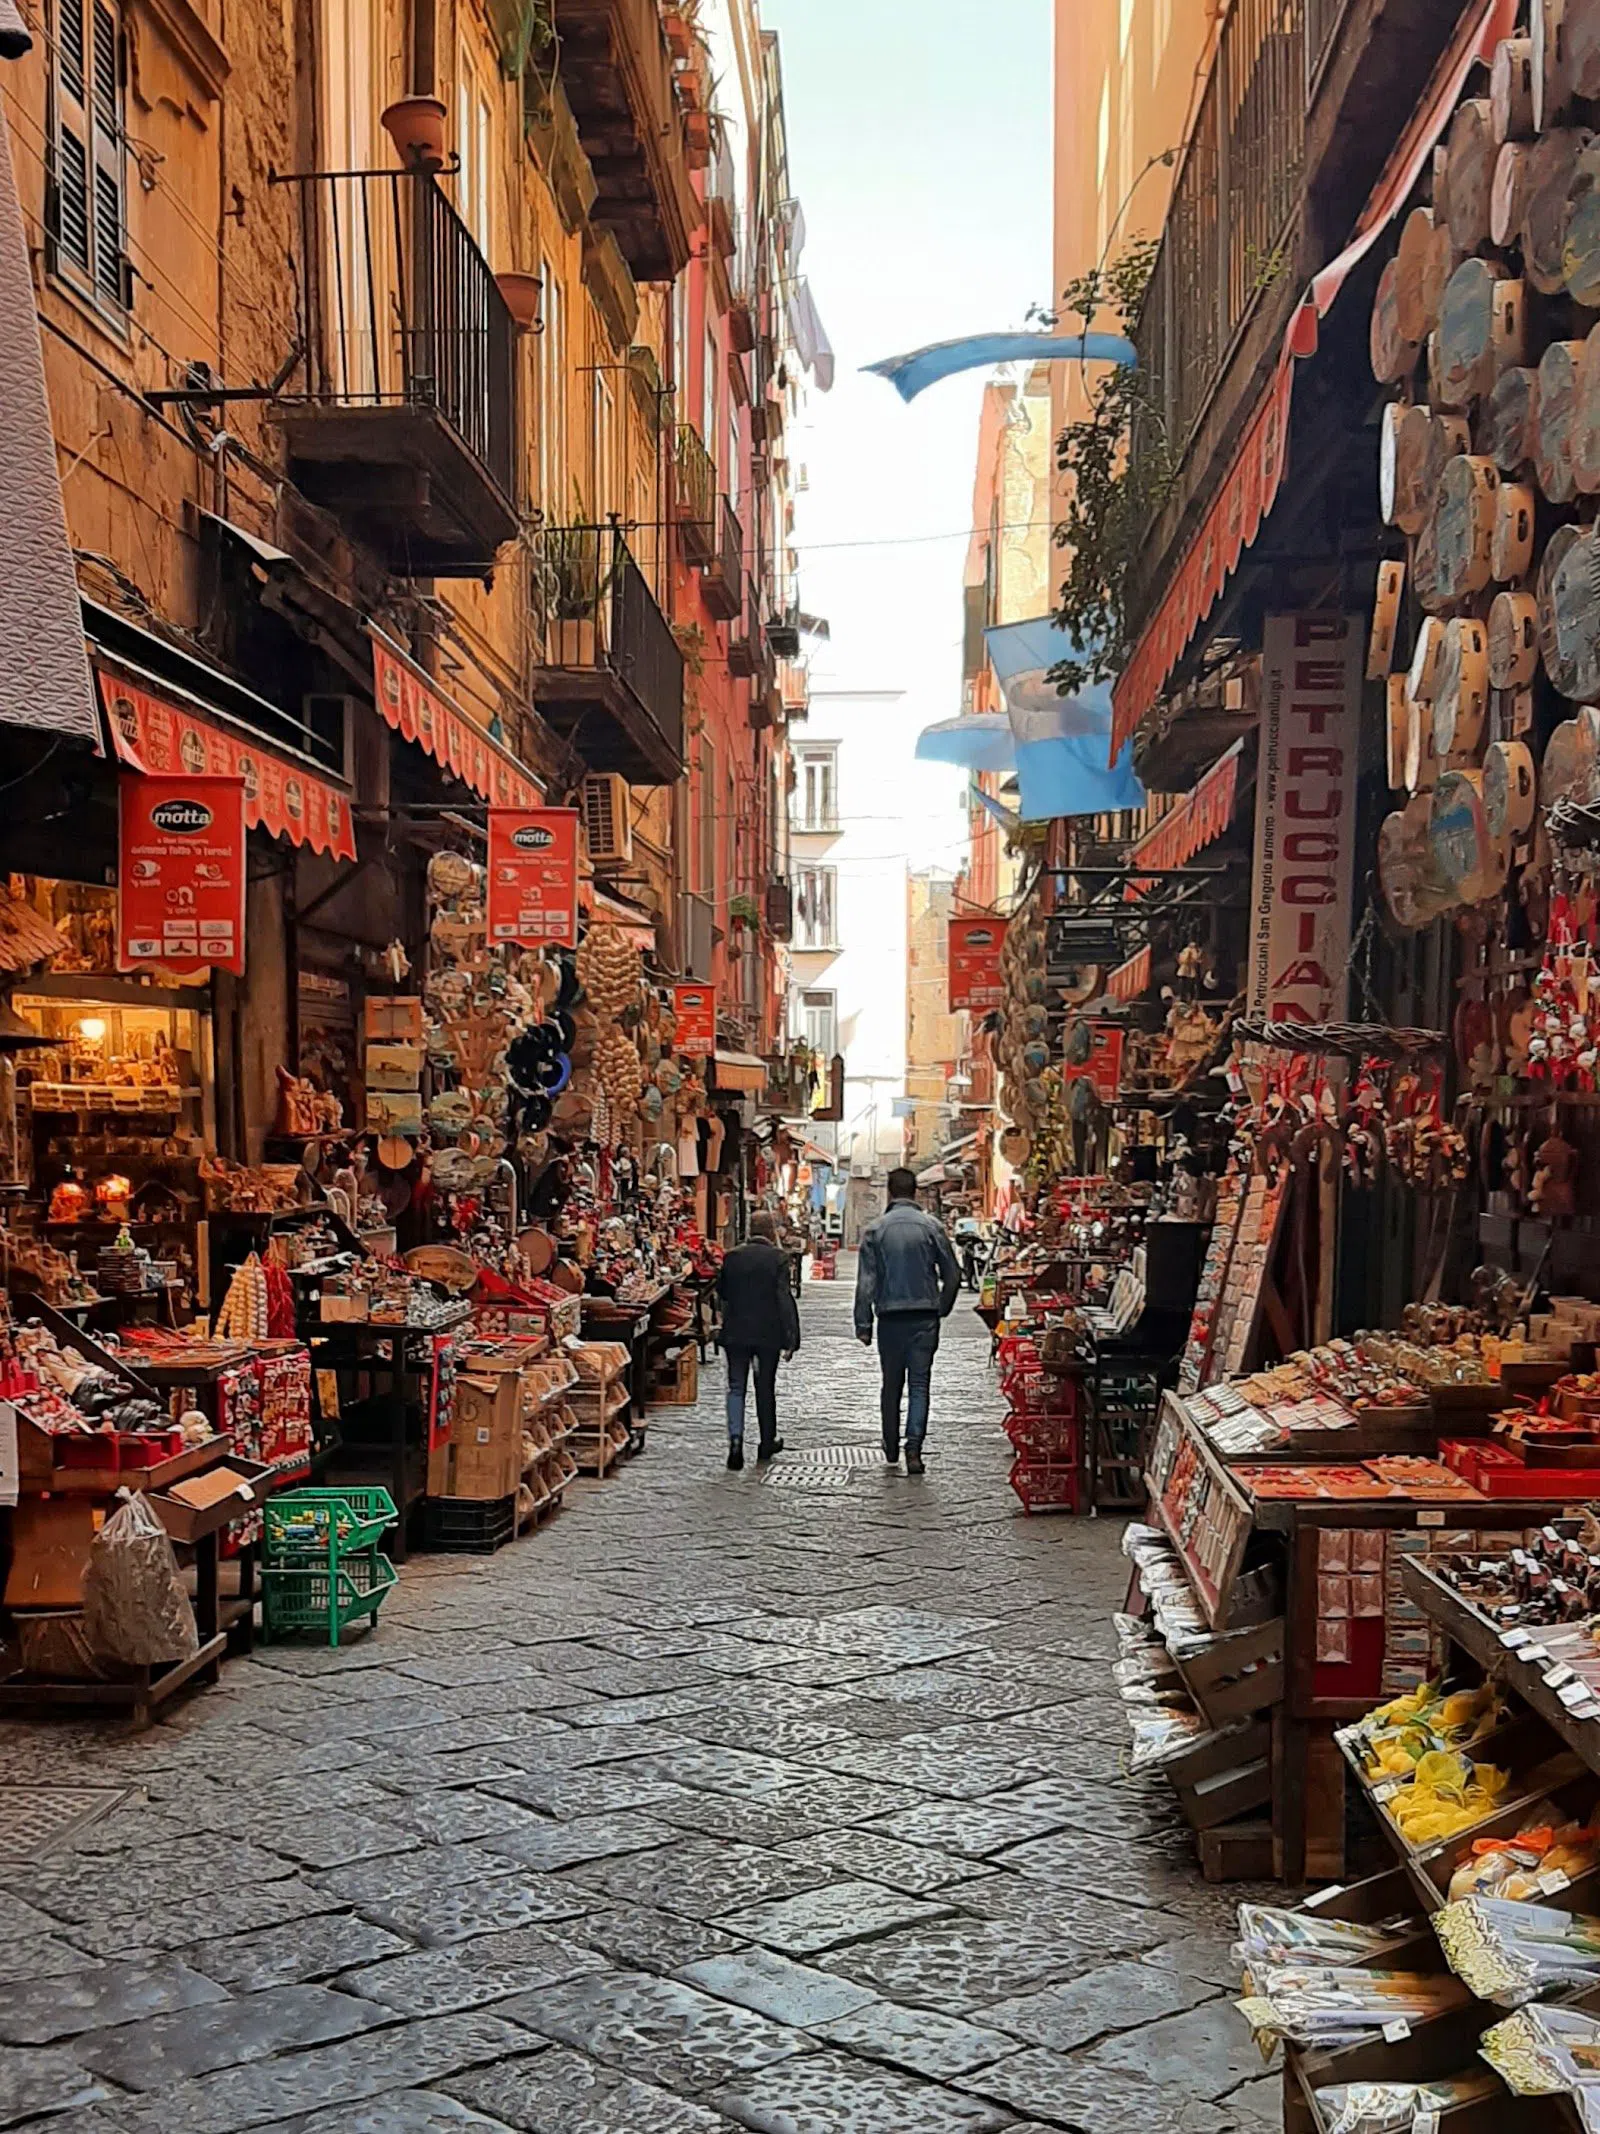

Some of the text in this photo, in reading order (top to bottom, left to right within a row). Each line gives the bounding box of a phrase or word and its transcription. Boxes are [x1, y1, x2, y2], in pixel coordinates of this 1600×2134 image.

[154, 809, 211, 824] motta
[1263, 816, 1275, 860] armeno
[1271, 618, 1350, 1023] PETRUCCIAN
[1257, 863, 1275, 914] Gregorio
[1256, 917, 1271, 939] San
